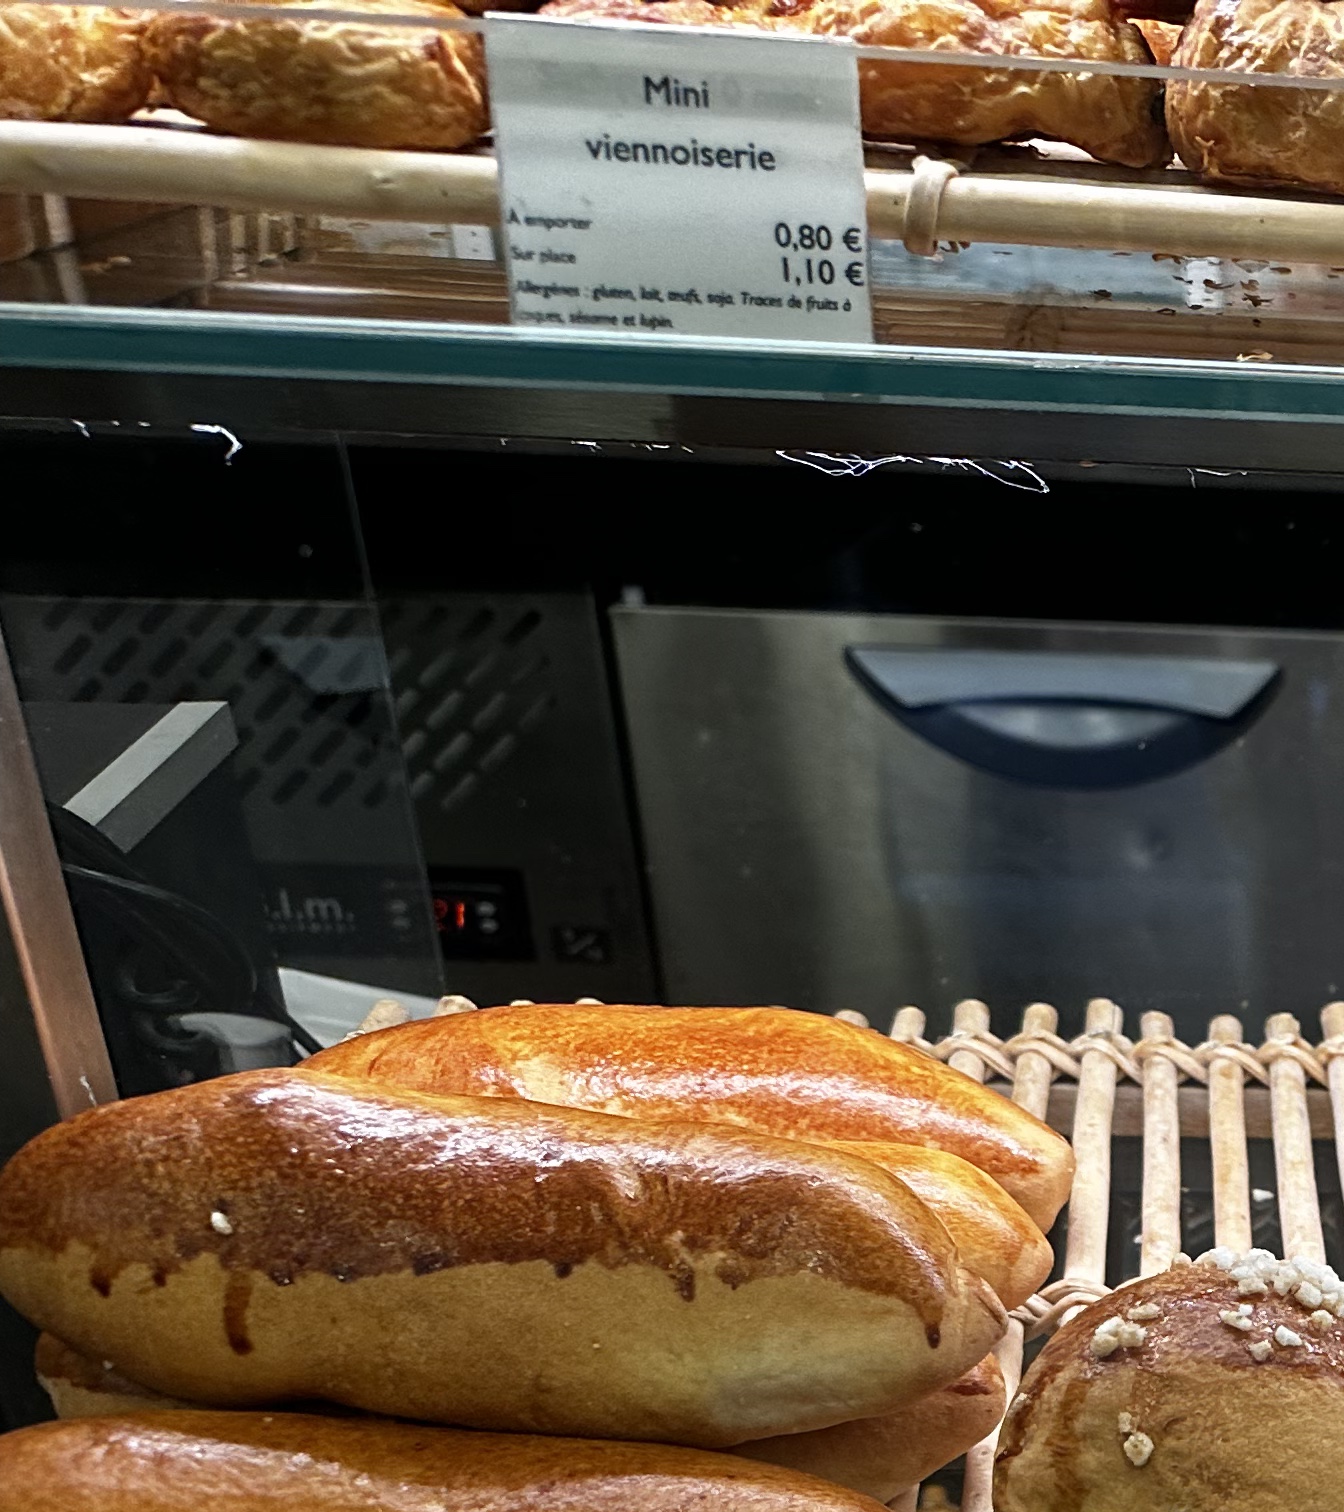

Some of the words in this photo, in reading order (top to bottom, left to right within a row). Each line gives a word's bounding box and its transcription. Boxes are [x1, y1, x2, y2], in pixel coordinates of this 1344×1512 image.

[643, 74, 709, 108] Mini
[586, 134, 777, 172] viennoiserie
[775, 222, 833, 252] 0,80
[843, 227, 863, 253] €
[782, 256, 836, 286] 1,10
[846, 261, 865, 287] €
